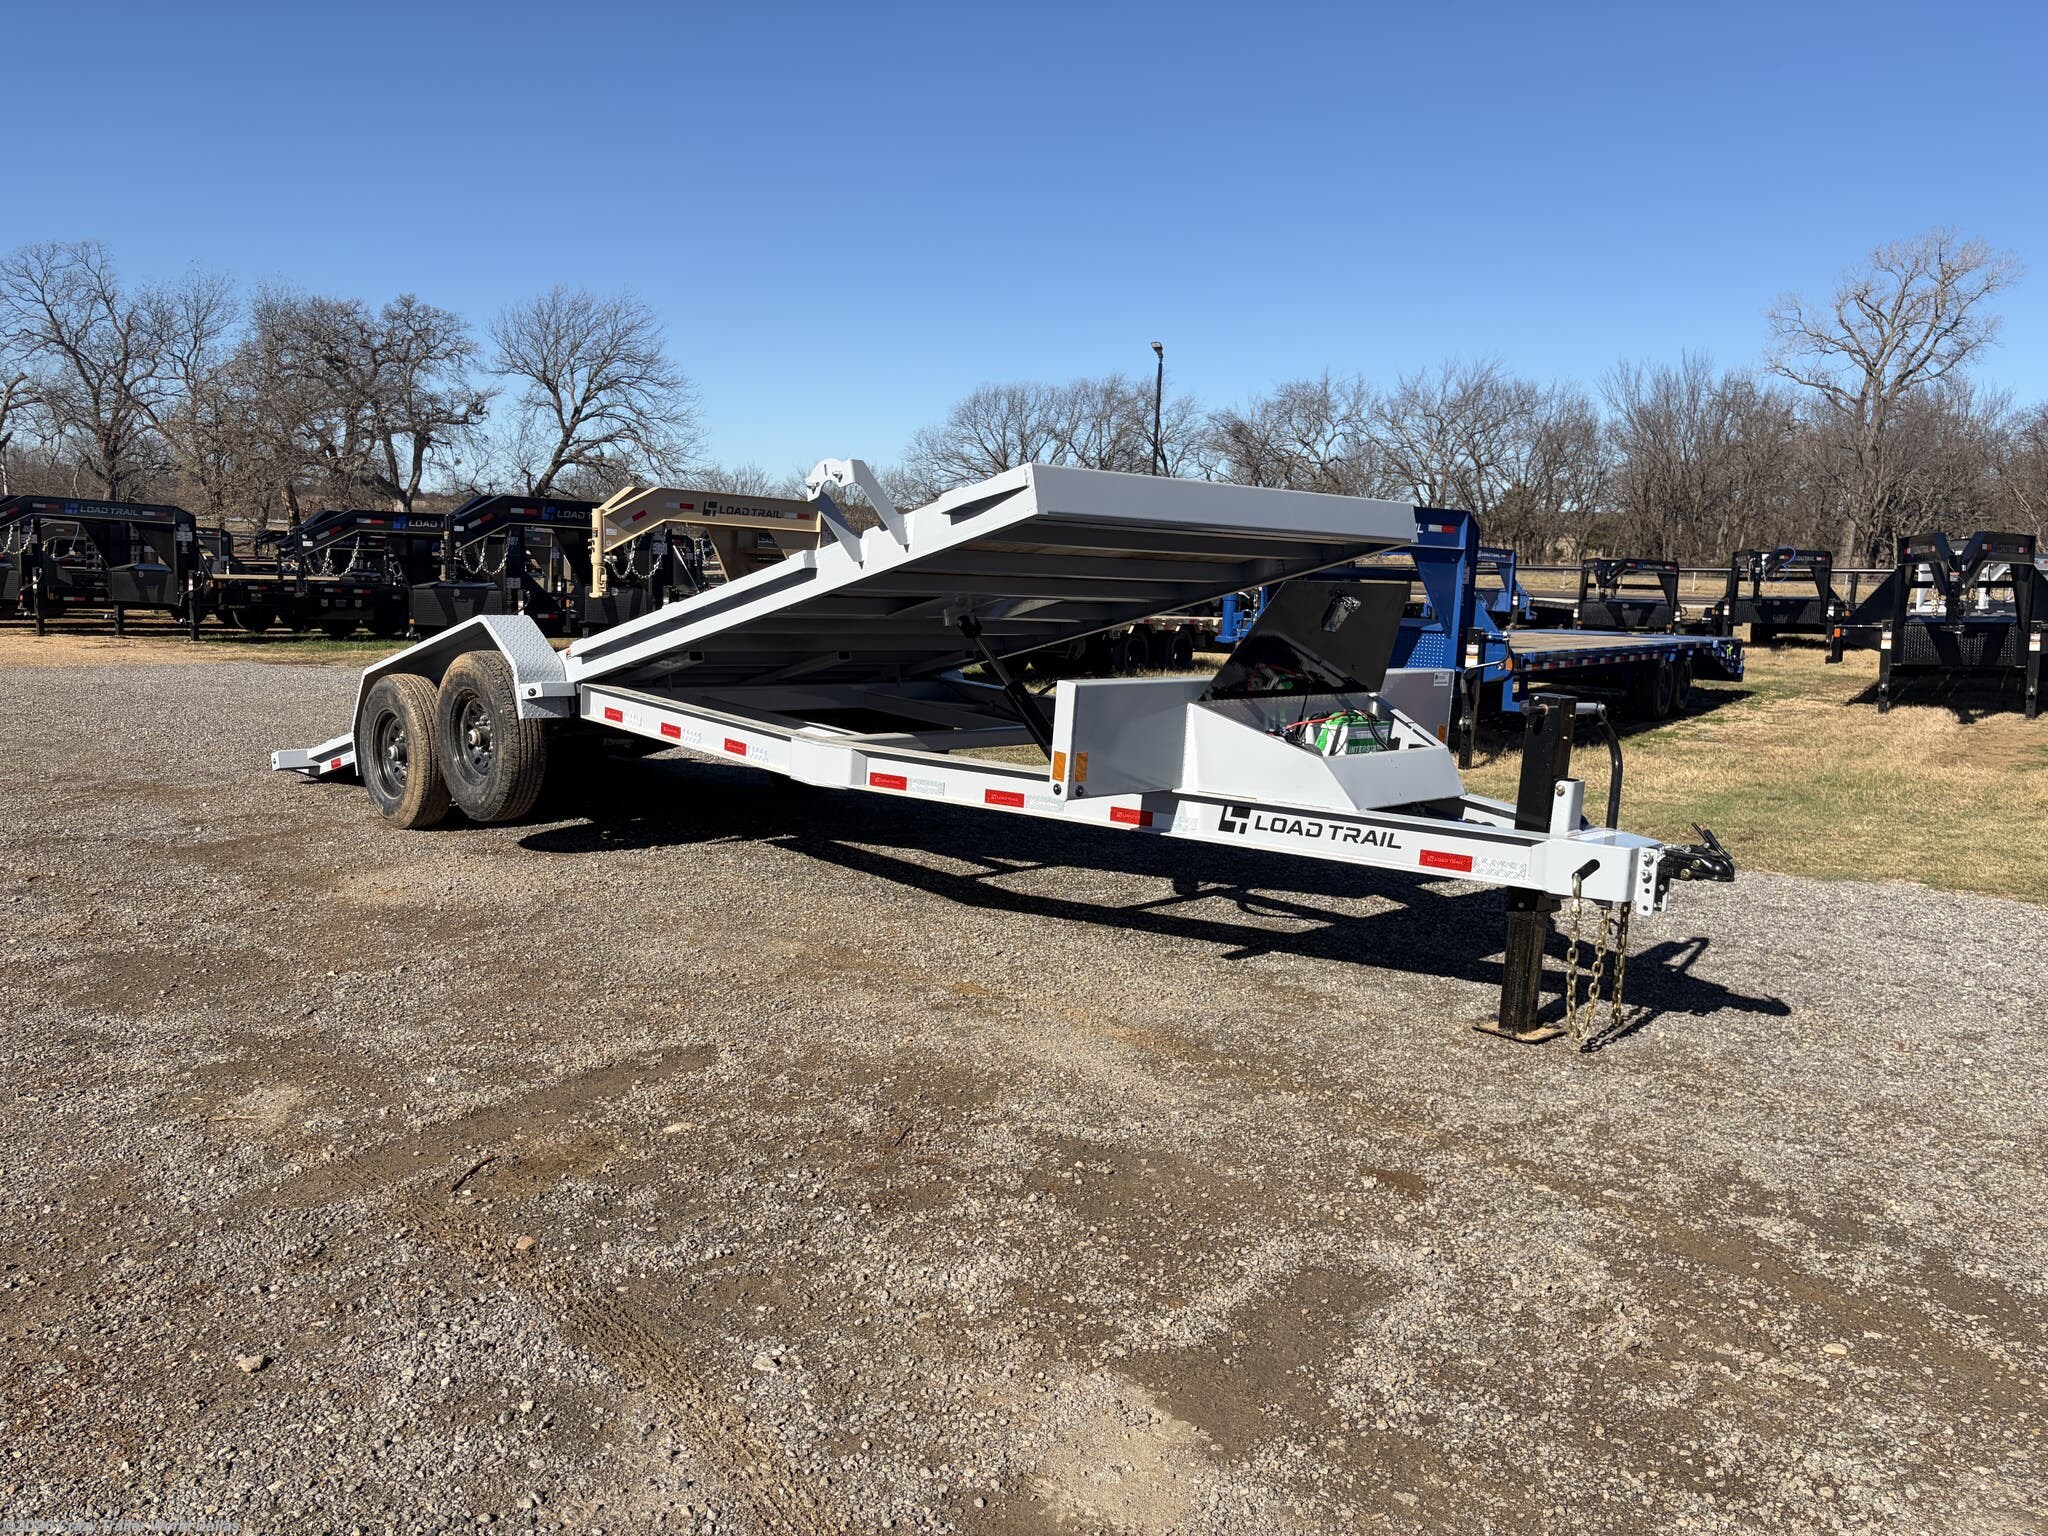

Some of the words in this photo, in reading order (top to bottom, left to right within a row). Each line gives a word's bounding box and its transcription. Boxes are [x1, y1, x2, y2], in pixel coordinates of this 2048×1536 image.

[80, 506, 109, 514] LOAD
[110, 508, 139, 516] TRAIL
[557, 510, 586, 519] LOAD
[719, 505, 750, 516] LOAD
[751, 508, 783, 518] TRAIL
[408, 519, 438, 528] LOAD
[1254, 815, 1323, 838] LOAD
[1329, 824, 1402, 849] TRAIL
